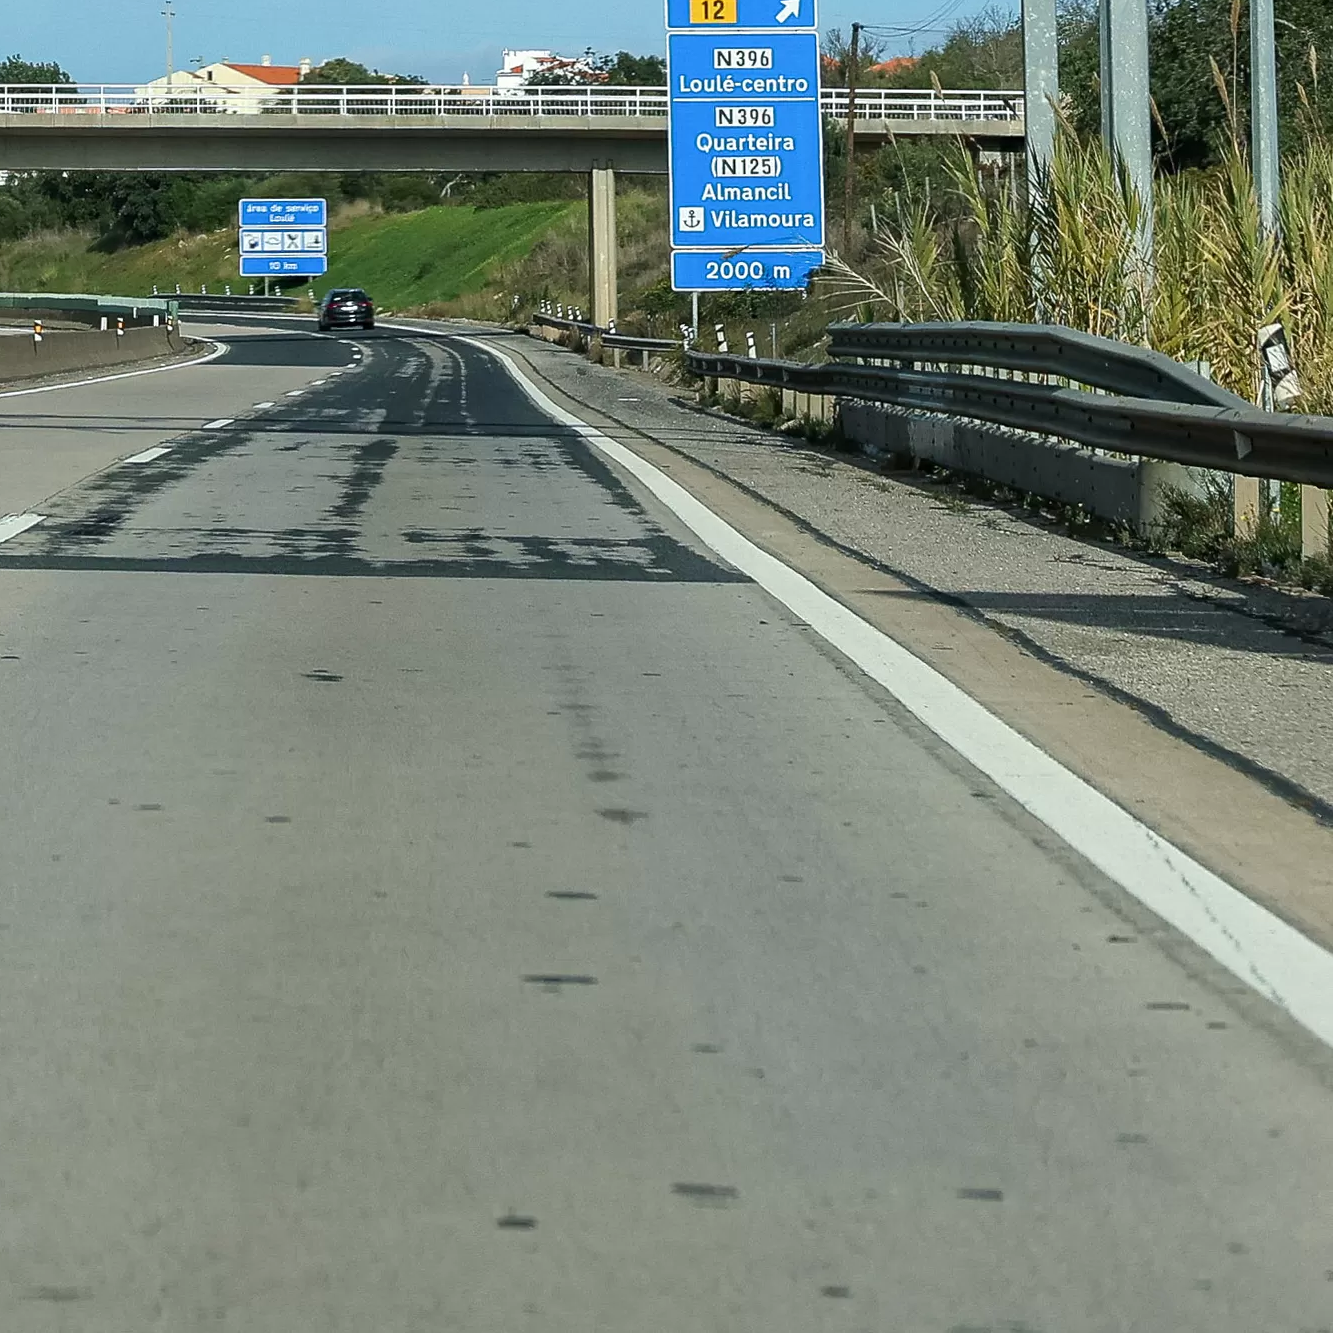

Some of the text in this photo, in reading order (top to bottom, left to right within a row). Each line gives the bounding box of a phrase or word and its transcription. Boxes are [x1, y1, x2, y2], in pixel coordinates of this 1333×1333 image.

[701, 0, 725, 20] 12
[717, 50, 770, 67] N396
[680, 75, 808, 93] Loulé-centro
[718, 108, 771, 125] N396
[696, 133, 794, 153] Quarteira
[711, 156, 782, 178] (N125)
[701, 183, 791, 201] Almancil
[270, 204, 283, 213] de
[711, 210, 815, 228] Vilamoura
[283, 262, 298, 270] km
[706, 262, 790, 280] 2000 m
